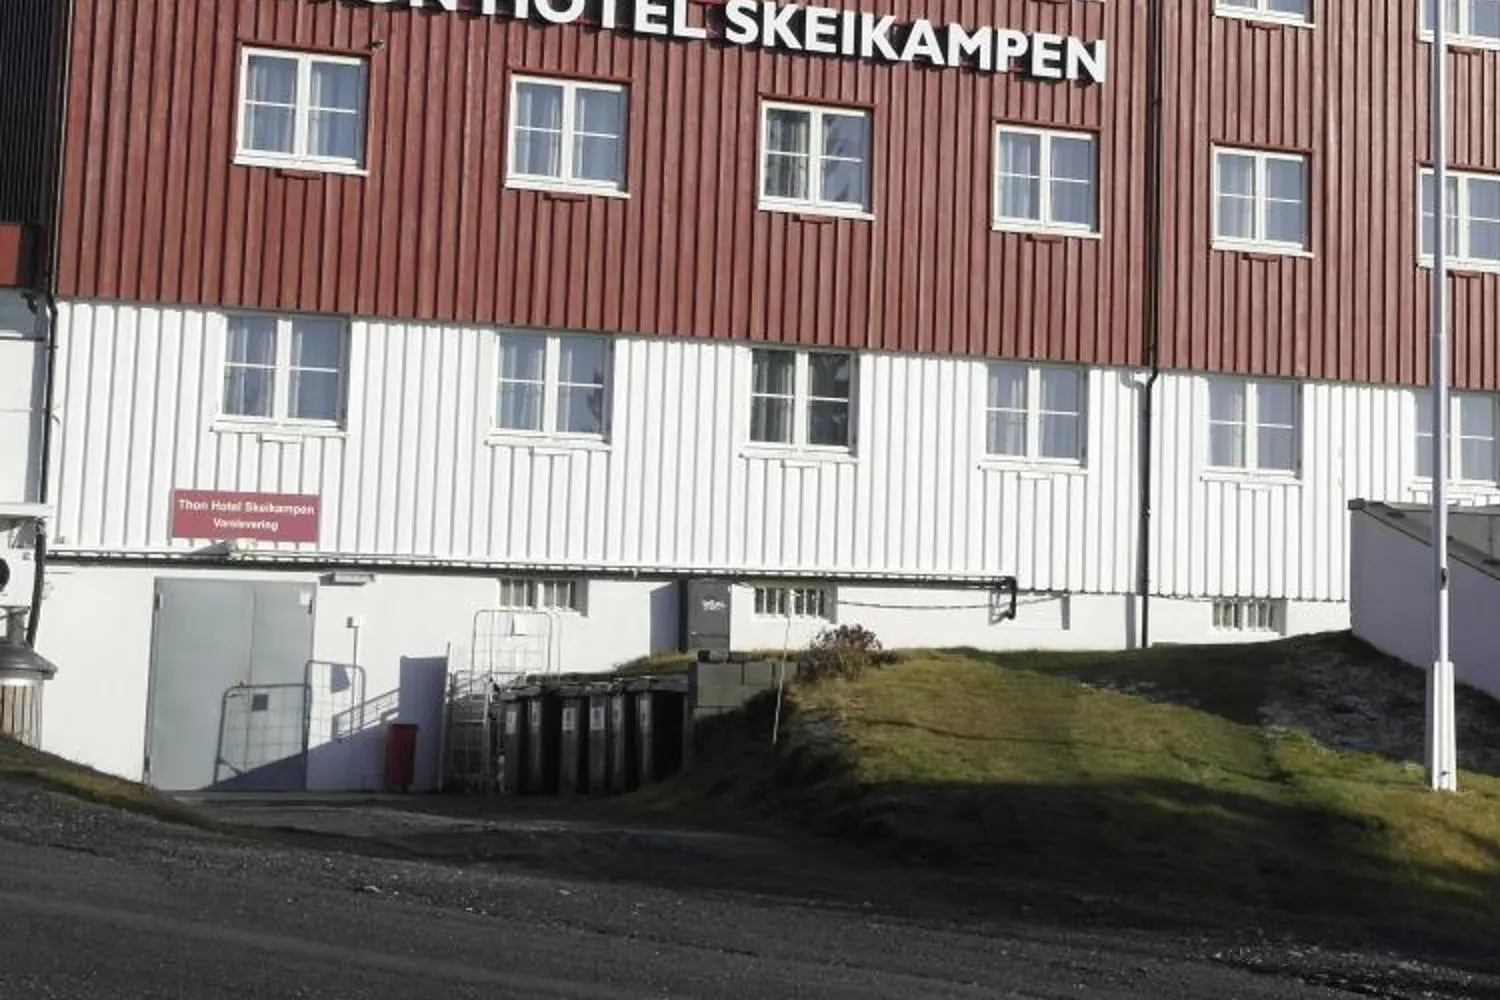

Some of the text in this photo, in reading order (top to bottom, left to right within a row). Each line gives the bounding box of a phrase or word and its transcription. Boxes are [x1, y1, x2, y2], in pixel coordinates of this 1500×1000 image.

[179, 499, 315, 517] Thon Hotel Skeikampen
